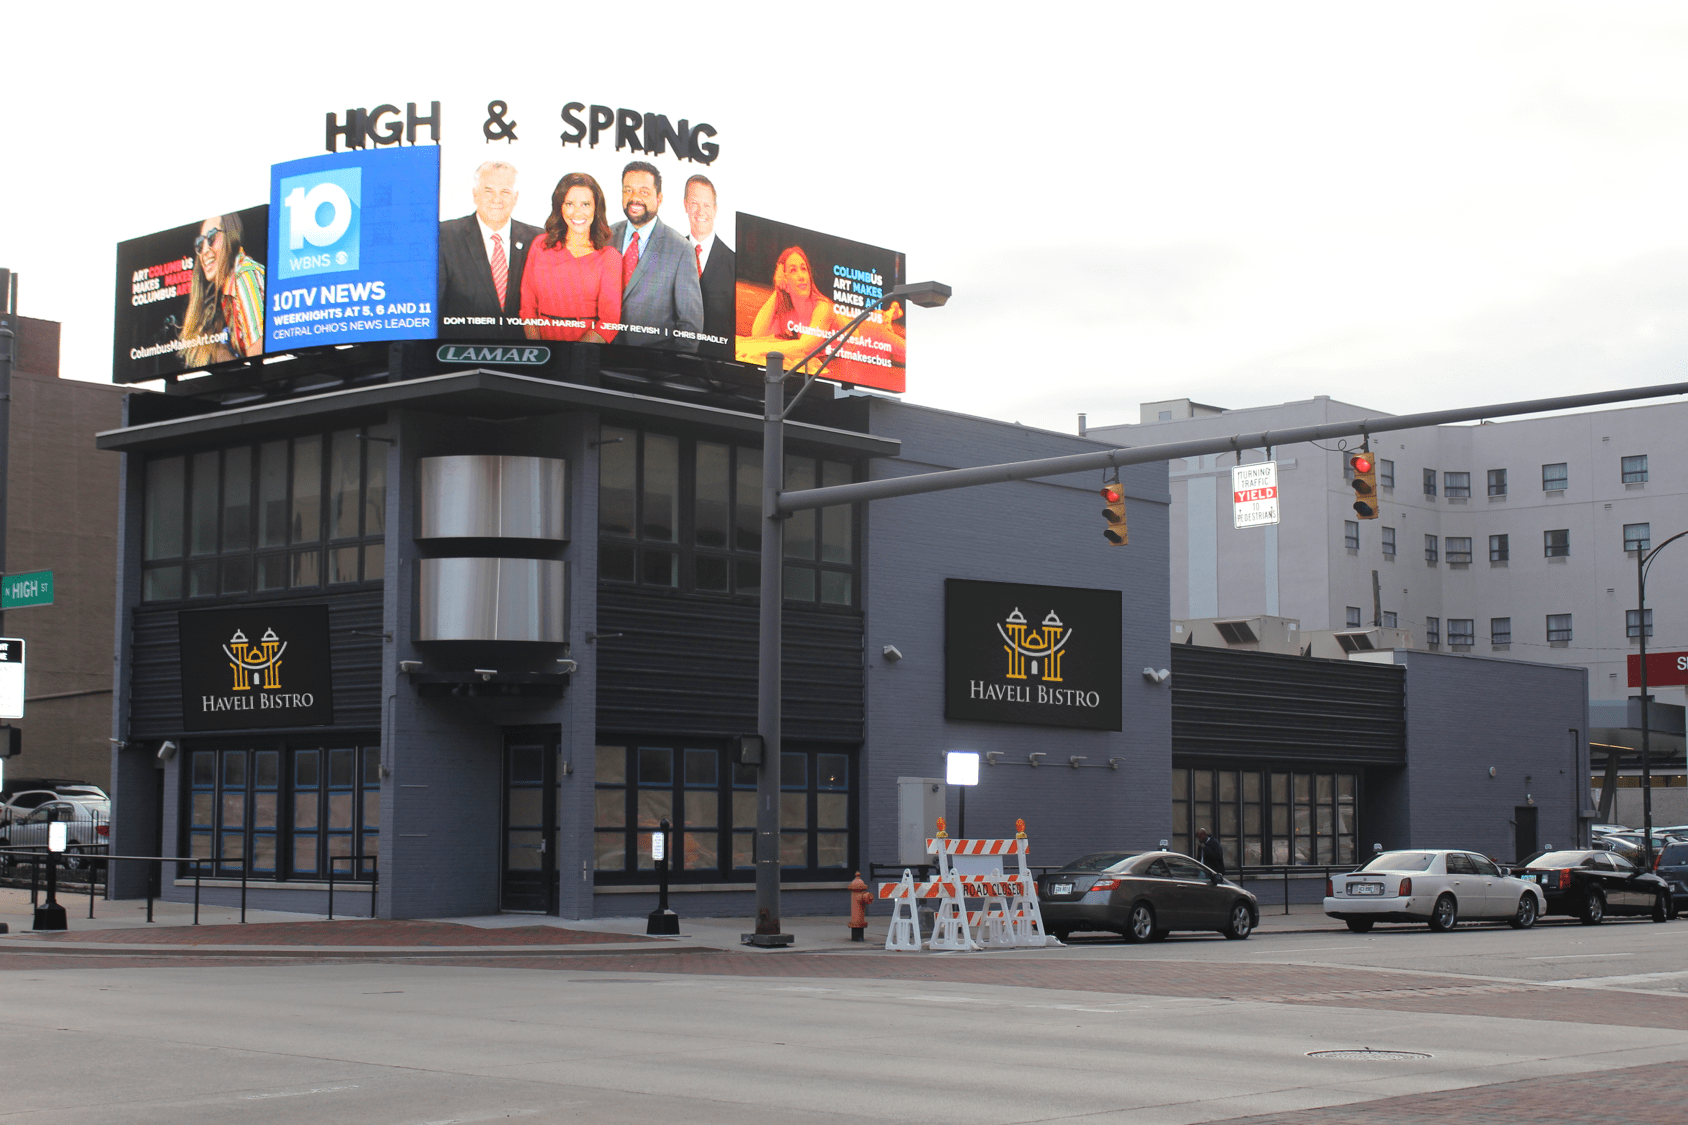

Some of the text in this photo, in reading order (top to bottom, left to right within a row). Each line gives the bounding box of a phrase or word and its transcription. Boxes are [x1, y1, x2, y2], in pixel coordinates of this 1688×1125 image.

[326, 100, 719, 165] HIGH & SPRING
[285, 183, 352, 250] 10
[290, 254, 331, 271] WBNS
[132, 268, 149, 282] ART
[132, 270, 193, 294] MAKES MAKES
[833, 265, 883, 286] COLUMBUS
[131, 281, 192, 306] COLUMBUS ART
[273, 281, 386, 311] 10TV NEWS
[833, 277, 883, 298] ART MAKES
[833, 289, 864, 307] MAKES
[273, 303, 432, 326] WEEKNIGHTS AT 5, 6 AND 11
[833, 303, 883, 324] COLUMUS
[273, 318, 430, 340] CENTRAL OHIO'S NEWS LEADER
[443, 317, 729, 345] DOM TIBERI YOLANDA HARRIS JERRY REVISH CHRIS BRADLEY
[130, 331, 229, 360] ColumbusMakesArt.com
[446, 347, 539, 361] LAMAR
[1238, 467, 1271, 479] TURNING
[1241, 477, 1269, 488] TRAFFIC
[1238, 488, 1273, 502] YIELD
[1237, 510, 1276, 522] PEDESTRIANS
[1252, 502, 1260, 511] TO
[5, 580, 48, 599] N HIGH ST
[202, 692, 314, 711] HAVELI BISTRO
[970, 680, 1100, 708] HAVELI BISTRO
[963, 883, 1022, 896] ROAD CLOSED
